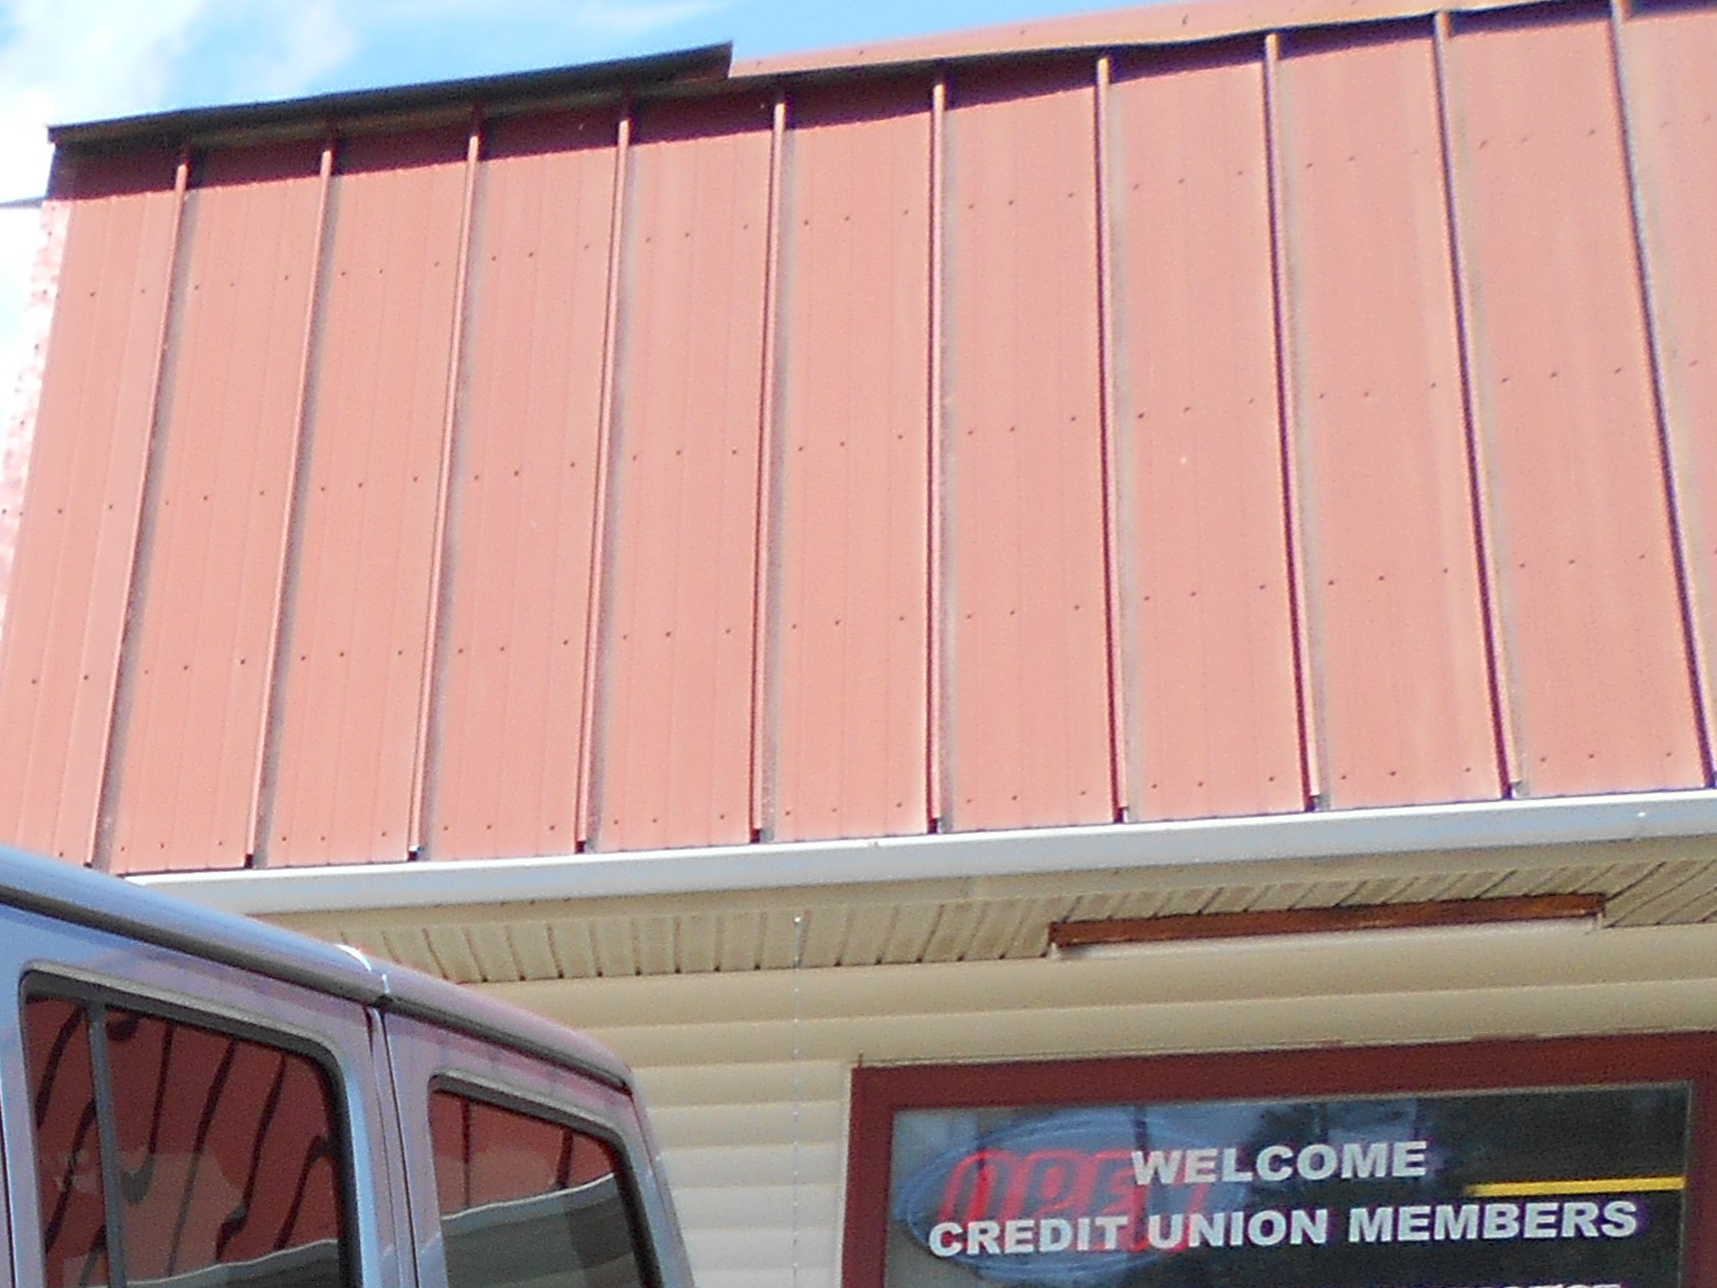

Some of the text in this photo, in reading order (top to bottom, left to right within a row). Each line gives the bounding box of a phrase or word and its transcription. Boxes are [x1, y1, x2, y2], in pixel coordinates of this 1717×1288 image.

[1131, 1140, 1428, 1186] WELCOME
[928, 1200, 1638, 1257] CREDIT UNION MEMBERS
